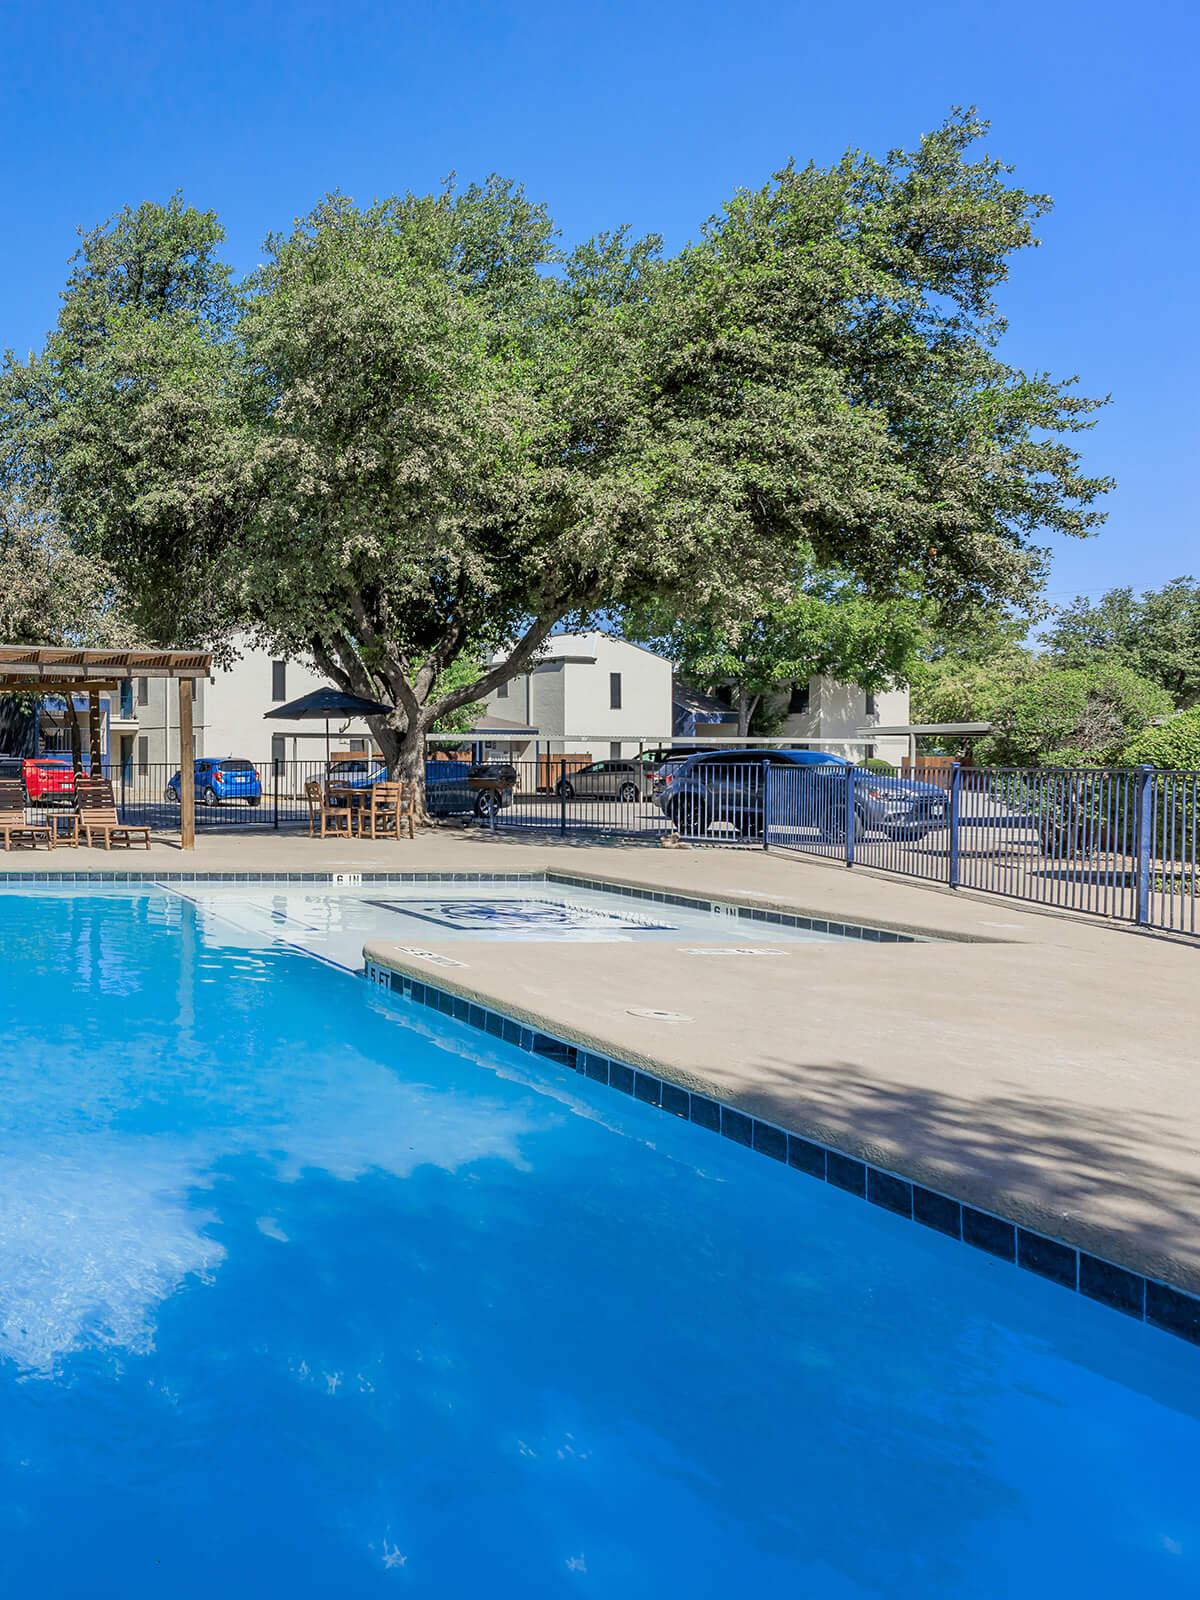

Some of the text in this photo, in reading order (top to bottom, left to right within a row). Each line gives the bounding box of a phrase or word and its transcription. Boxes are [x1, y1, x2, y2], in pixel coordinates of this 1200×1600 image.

[337, 875, 359, 884] 6 IN
[714, 906, 736, 916] 6 IN
[371, 967, 390, 984] 5 FT
